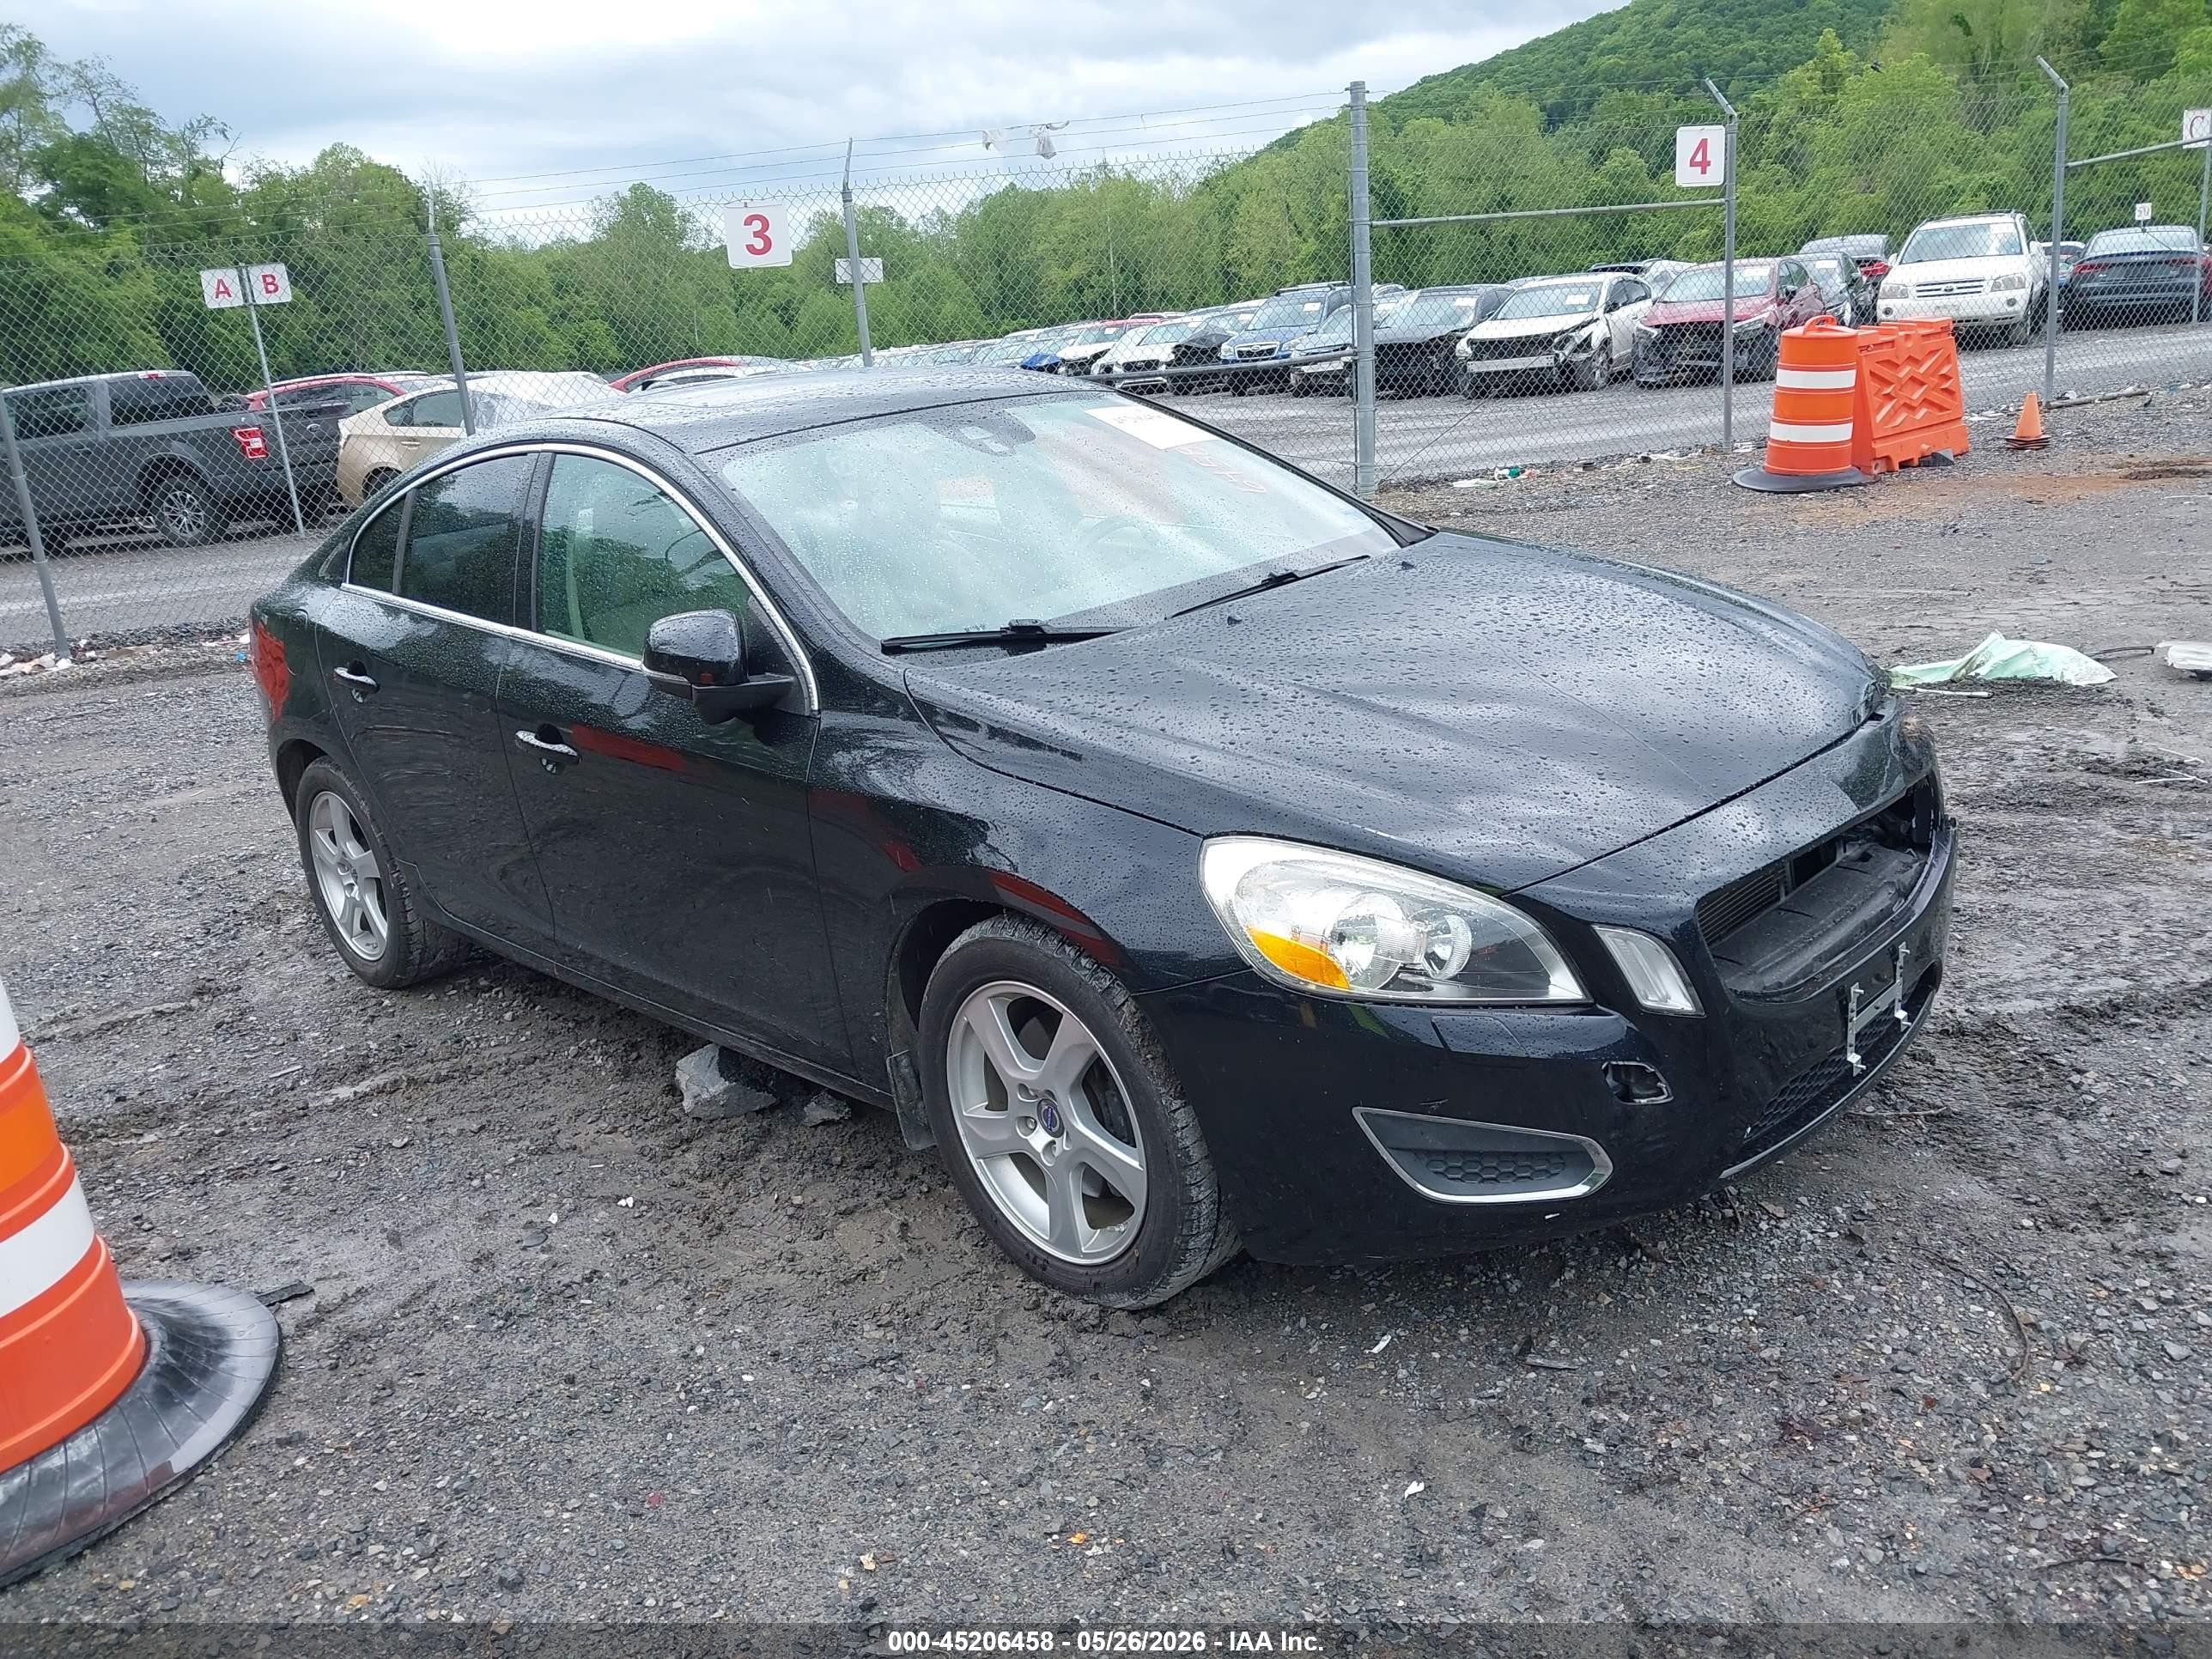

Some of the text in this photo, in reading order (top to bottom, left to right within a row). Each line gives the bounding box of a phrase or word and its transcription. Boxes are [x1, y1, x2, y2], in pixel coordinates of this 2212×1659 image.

[2190, 115, 2205, 138] C
[1689, 137, 1711, 175] 4
[744, 214, 773, 256] 3
[215, 278, 233, 299] A
[261, 274, 279, 295] B
